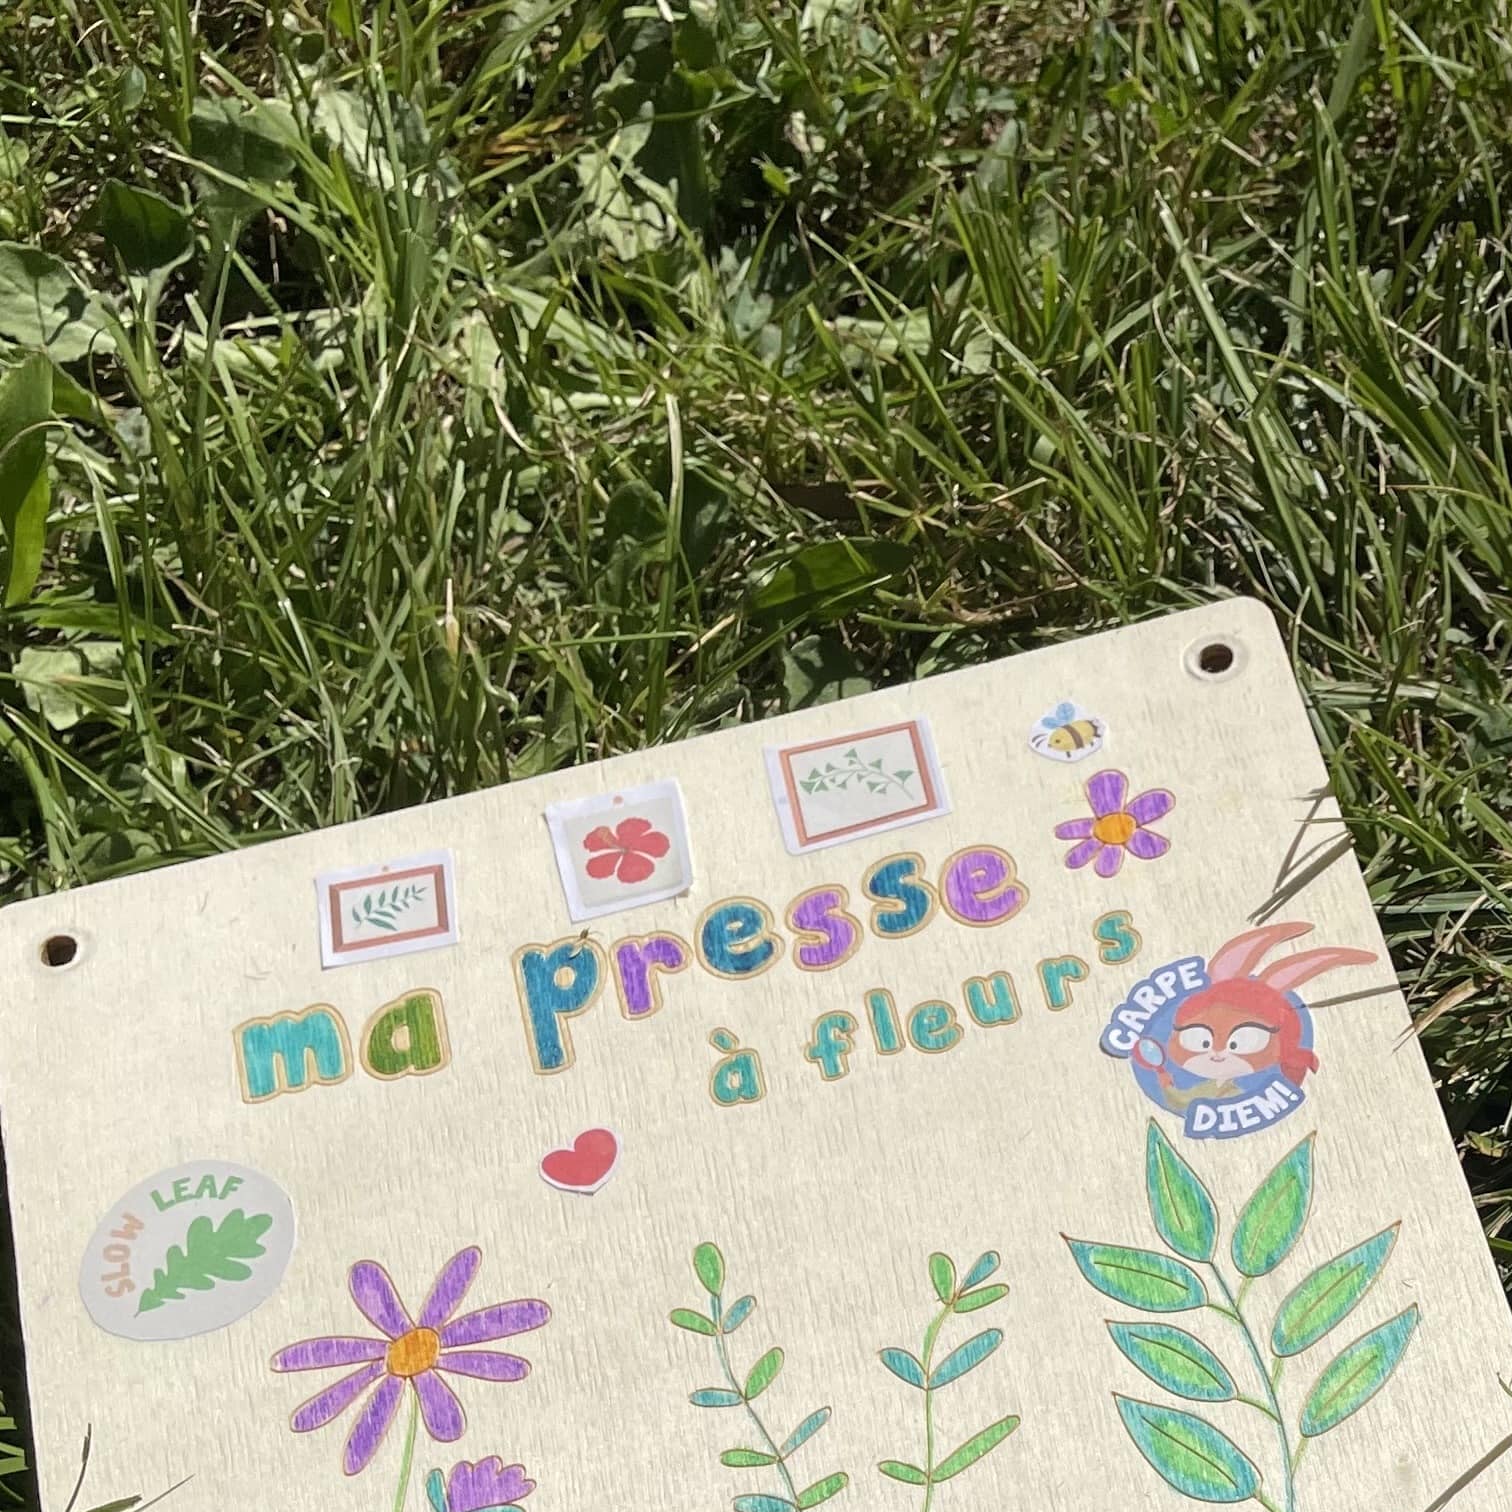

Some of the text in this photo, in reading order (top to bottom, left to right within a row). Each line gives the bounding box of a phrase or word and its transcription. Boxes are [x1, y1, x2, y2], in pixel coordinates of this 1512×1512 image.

[232, 844, 1030, 1105] ma presse
[709, 909, 1143, 1106] à fleurs
[1108, 961, 1300, 1133] CARPE DIEM!
[101, 1173, 244, 1298] SLOW LEAF
